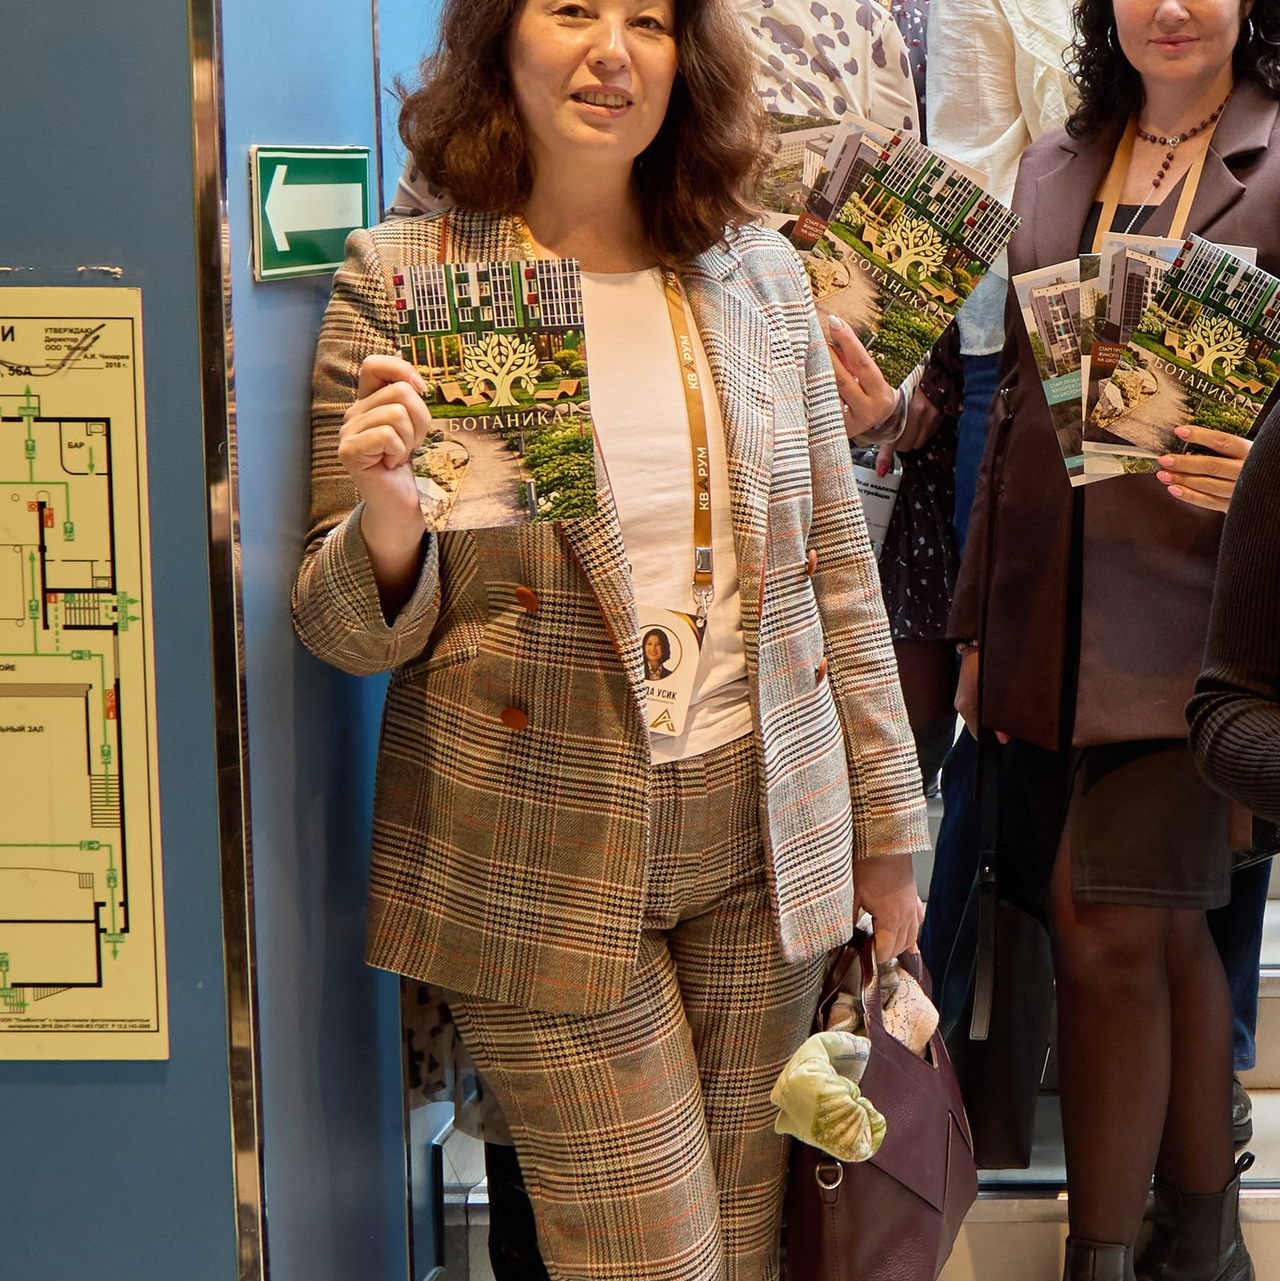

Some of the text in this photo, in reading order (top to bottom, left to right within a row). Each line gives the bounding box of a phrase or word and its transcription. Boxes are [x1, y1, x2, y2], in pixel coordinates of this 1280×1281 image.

[848, 251, 930, 316] БОТАНИКА
[44, 327, 92, 335] УТВЕРЖДАЮ
[44, 336, 79, 344] Директор
[1154, 357, 1238, 409] БОТАНИКА
[449, 410, 564, 432] БОТАНИКА
[657, 688, 677, 699] УСИК
